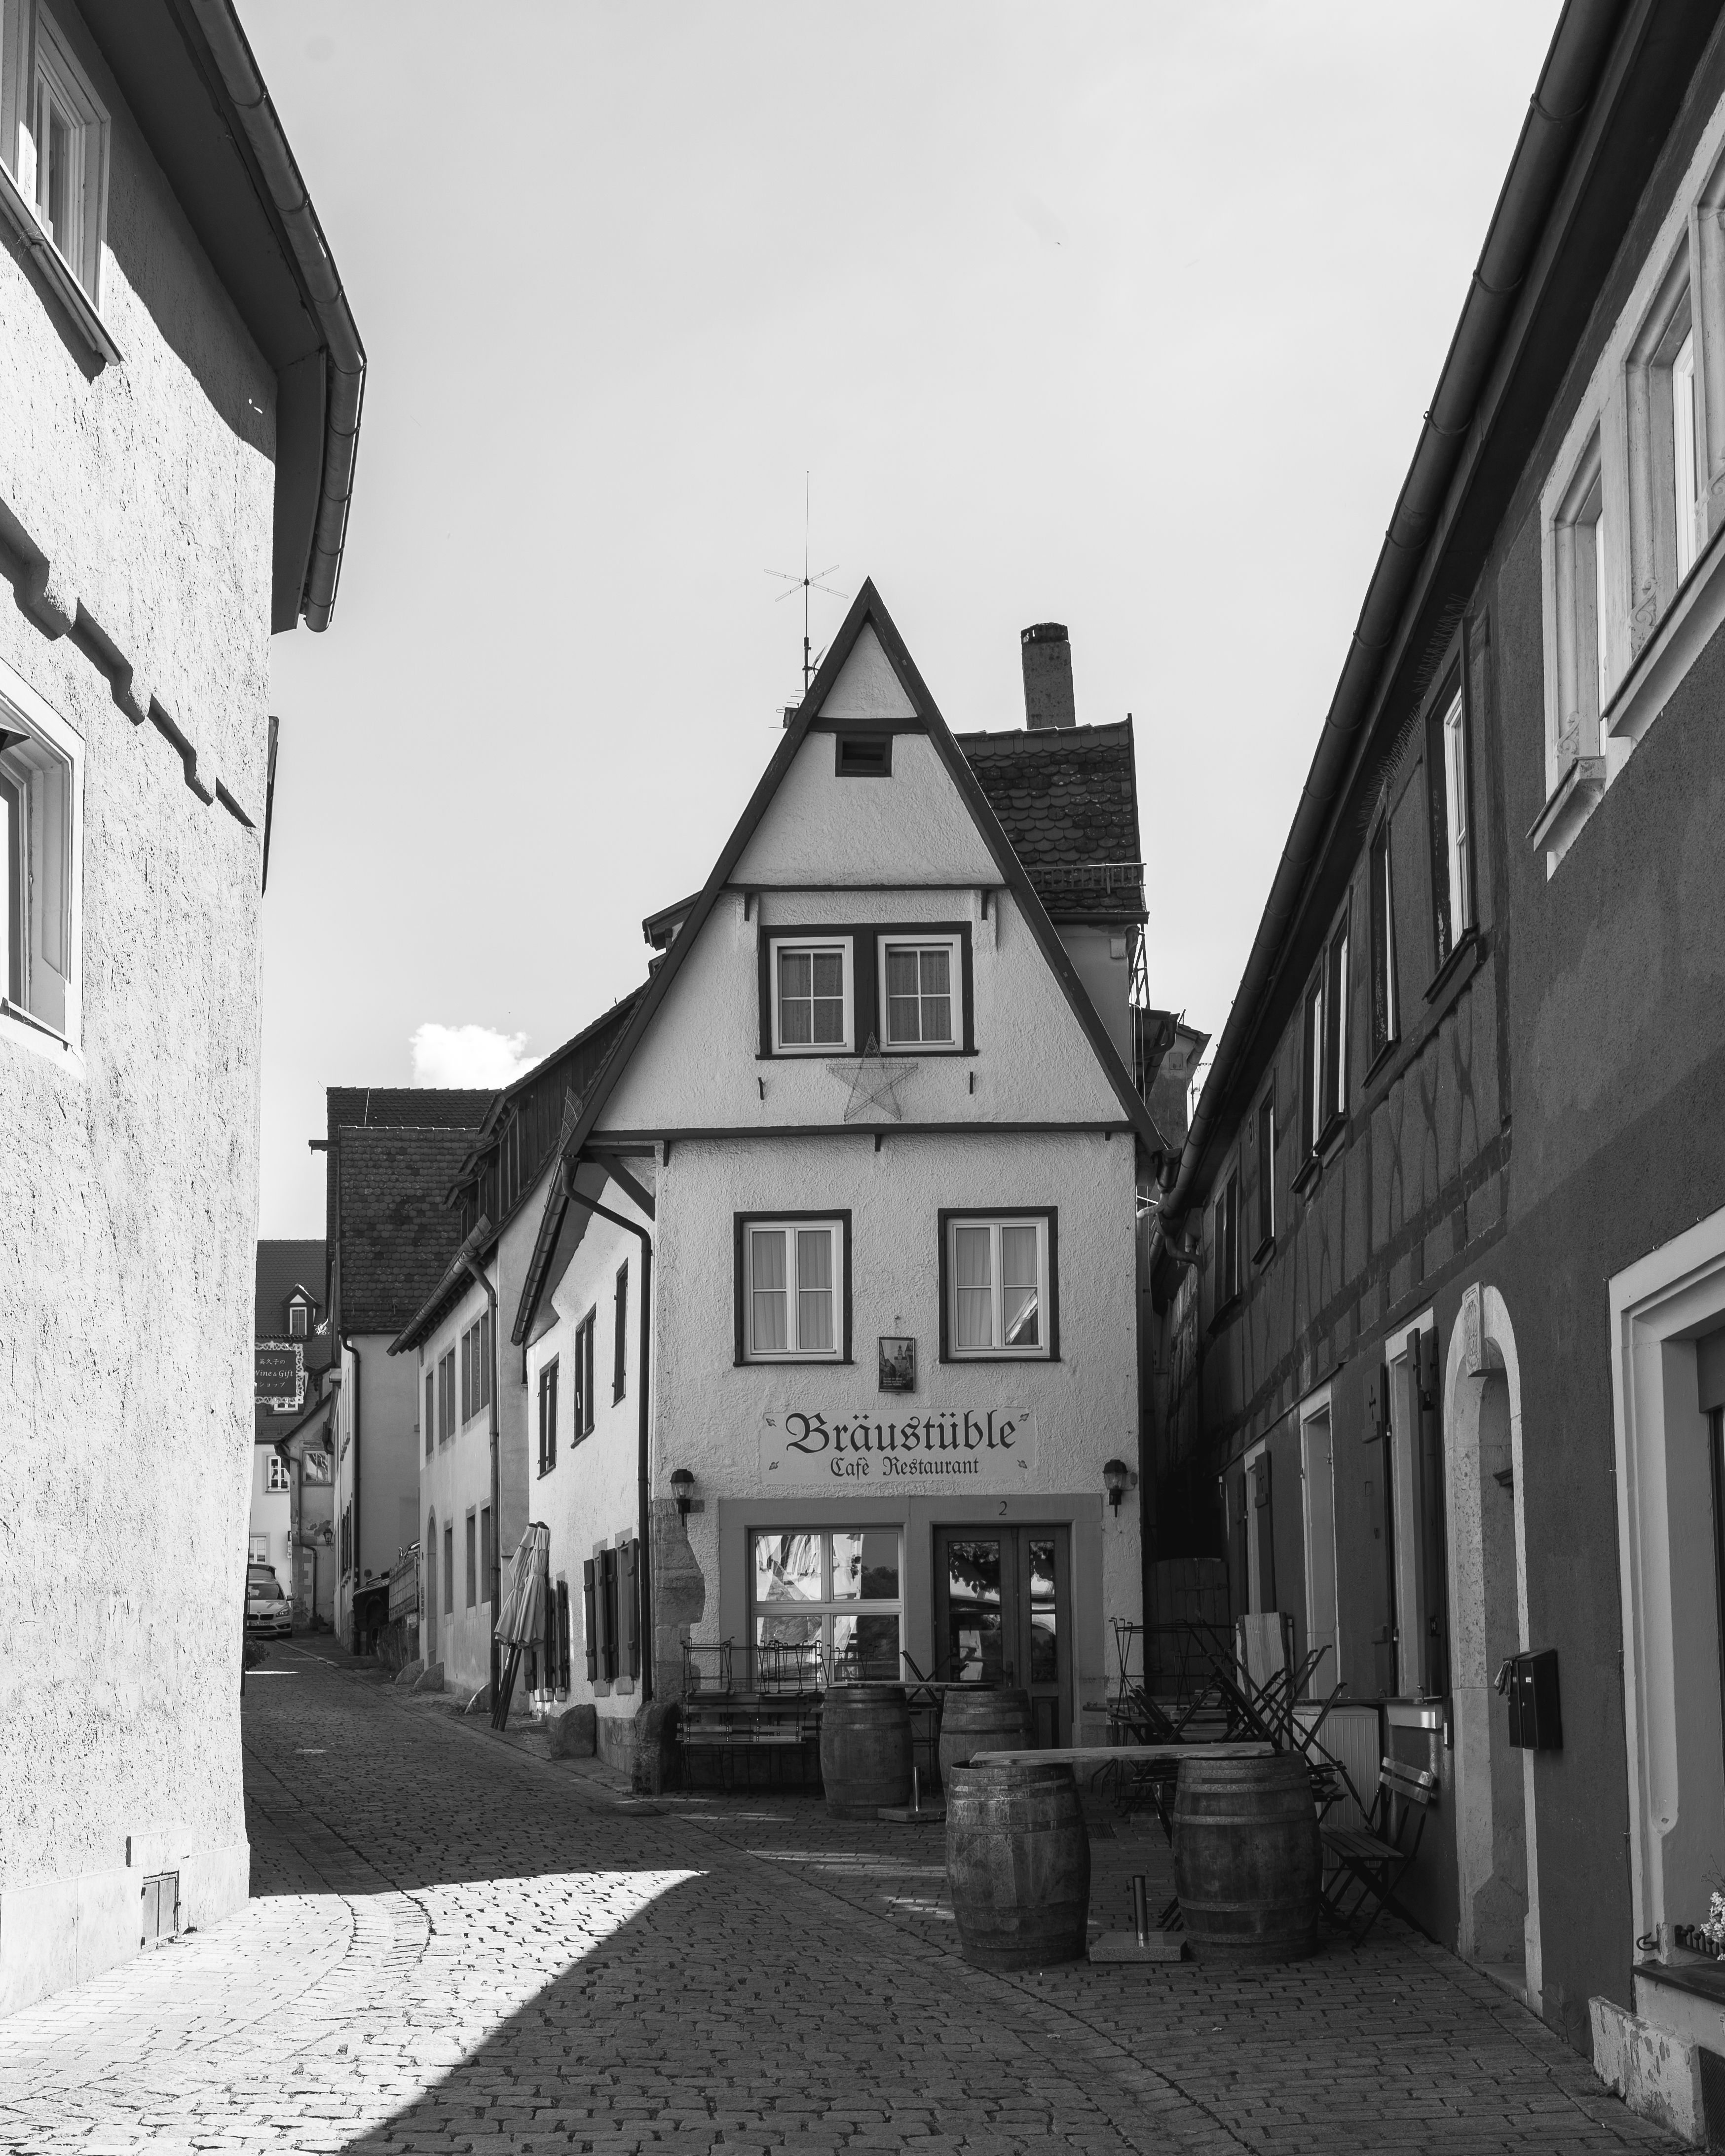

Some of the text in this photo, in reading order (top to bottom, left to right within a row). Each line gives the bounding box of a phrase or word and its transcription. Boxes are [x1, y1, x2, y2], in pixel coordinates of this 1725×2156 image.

[279, 1370, 293, 1379] Gift
[786, 1409, 1016, 1453] Bräustüble
[882, 1456, 979, 1476] Restaurant
[998, 1500, 1008, 1516] 2
